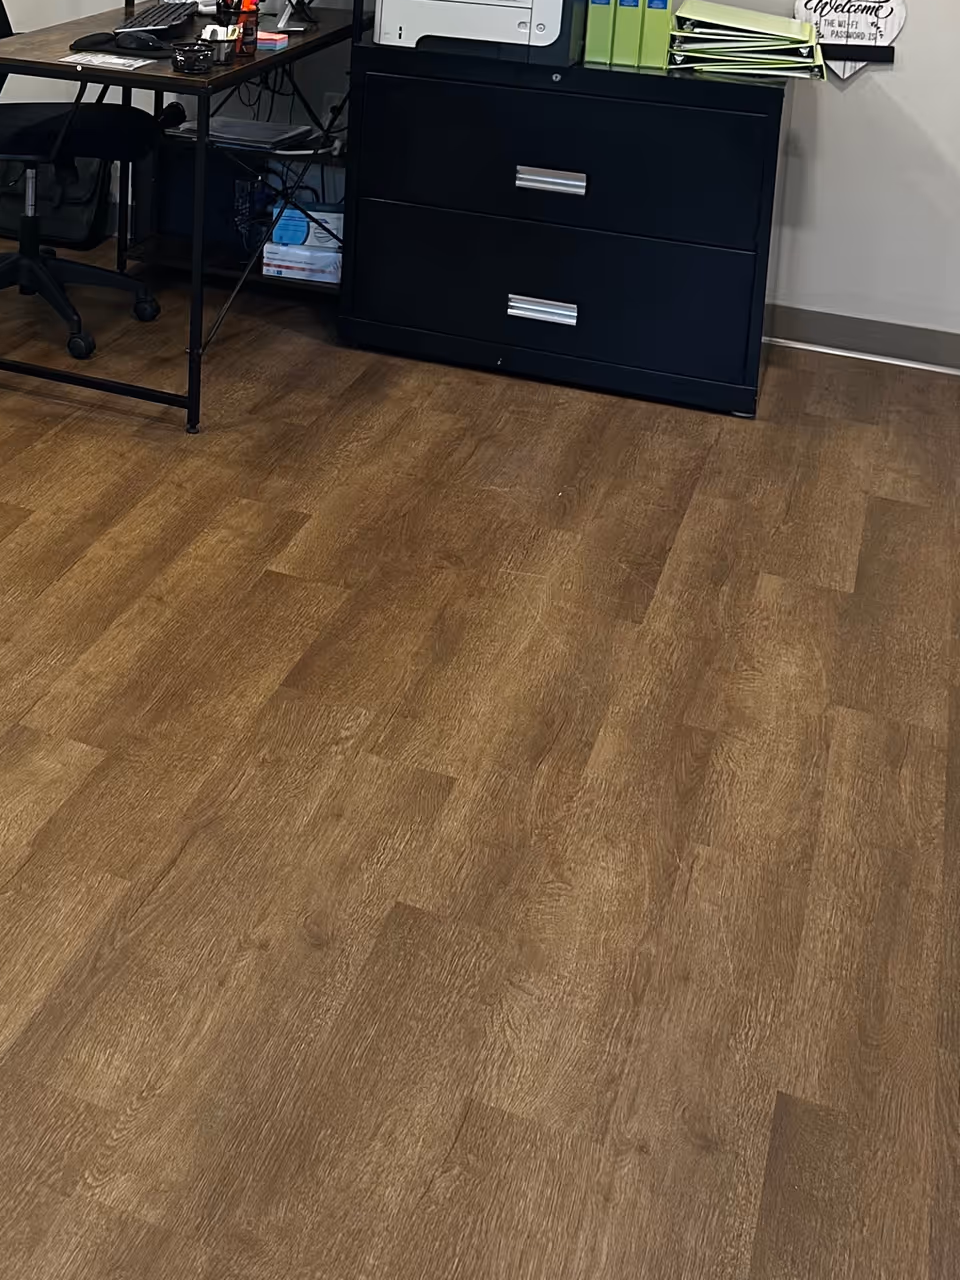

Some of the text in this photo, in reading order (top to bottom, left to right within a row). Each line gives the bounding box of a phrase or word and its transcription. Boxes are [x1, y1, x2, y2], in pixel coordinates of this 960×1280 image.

[824, 19, 836, 28] THE
[831, 30, 877, 41] PASSWORD IS
